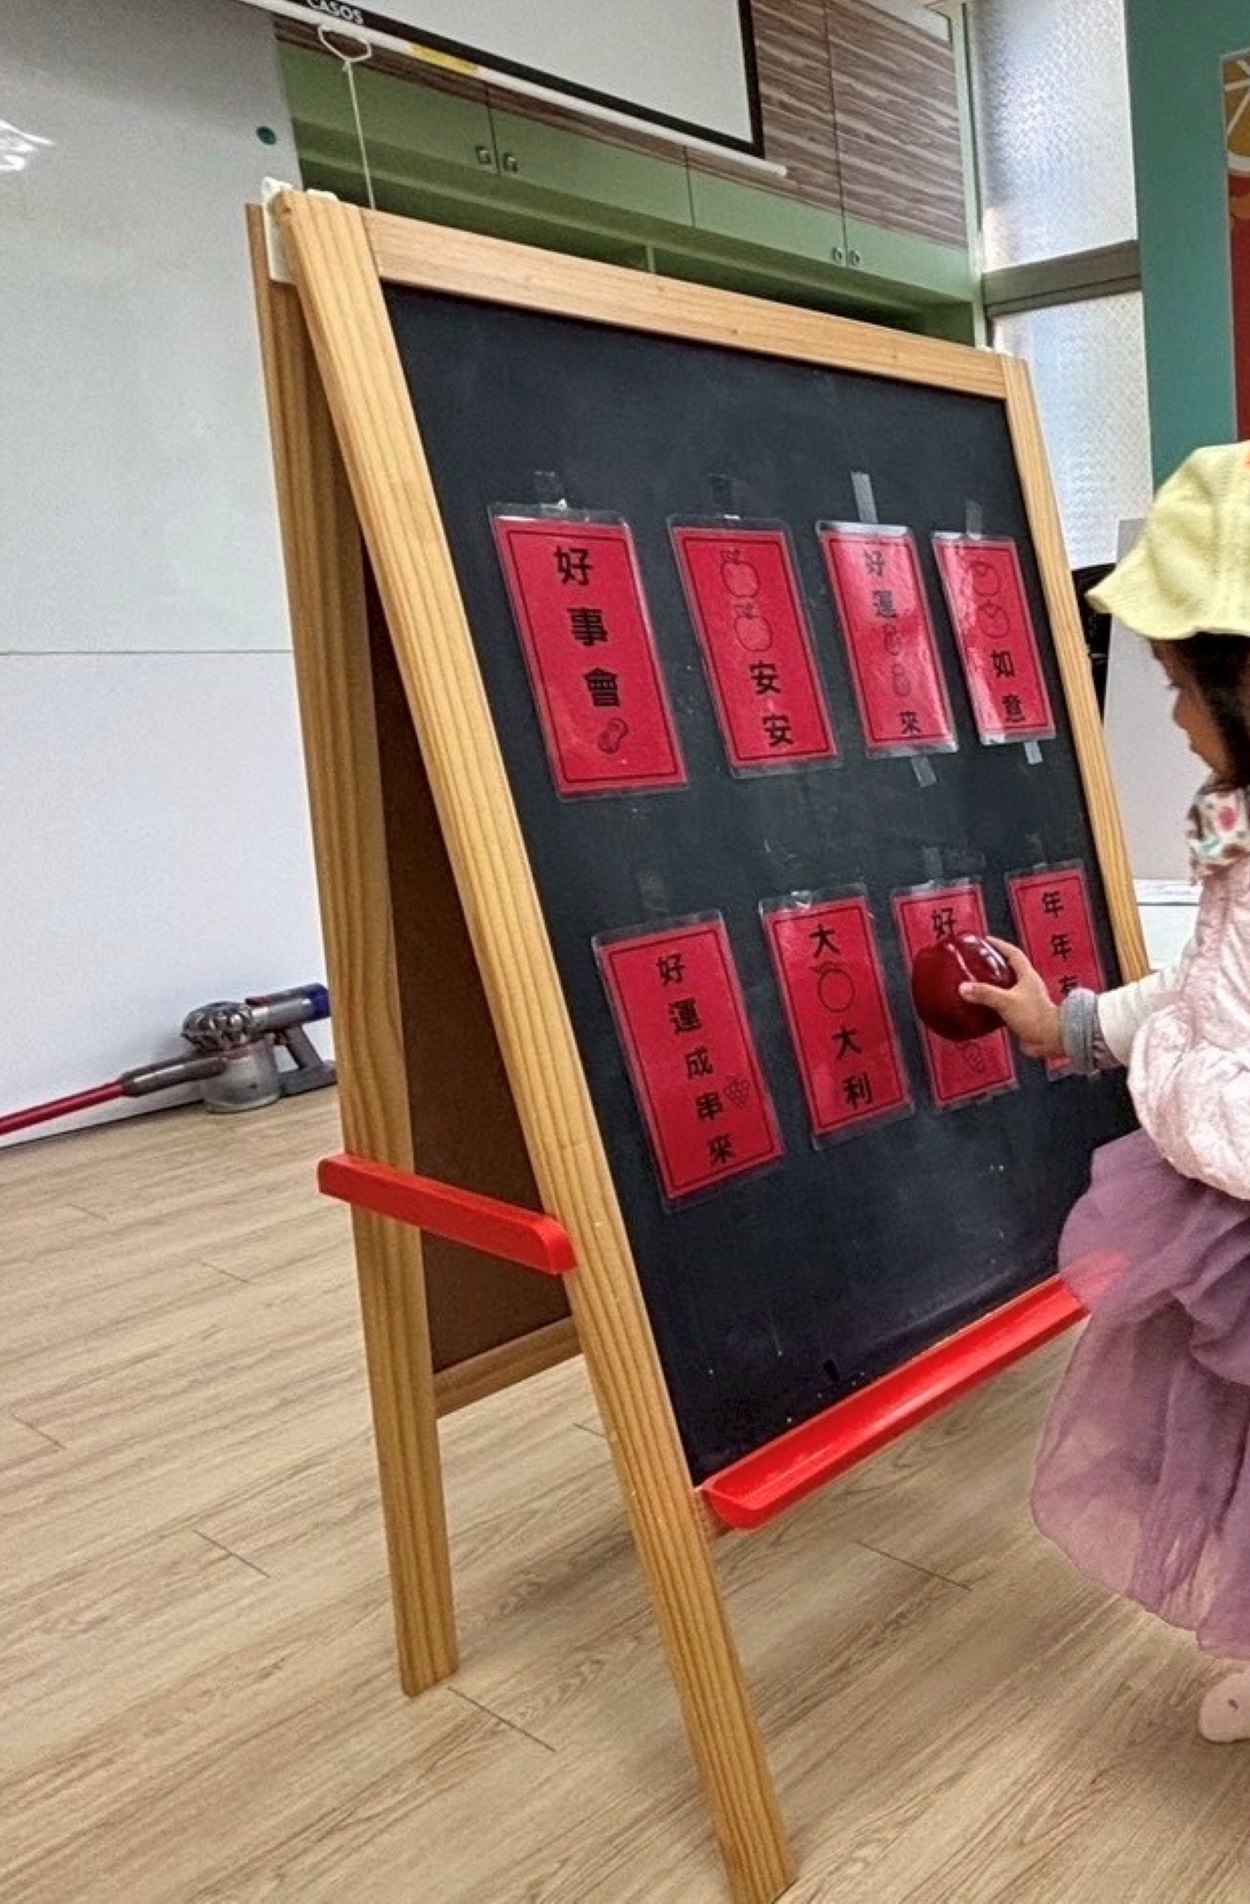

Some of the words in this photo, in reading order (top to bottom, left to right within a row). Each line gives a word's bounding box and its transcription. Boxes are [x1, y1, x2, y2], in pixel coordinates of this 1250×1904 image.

[552, 545, 622, 709] 好事會
[991, 649, 1026, 724] 如意
[750, 661, 794, 748] 安安
[655, 952, 736, 1166] 好運成串來
